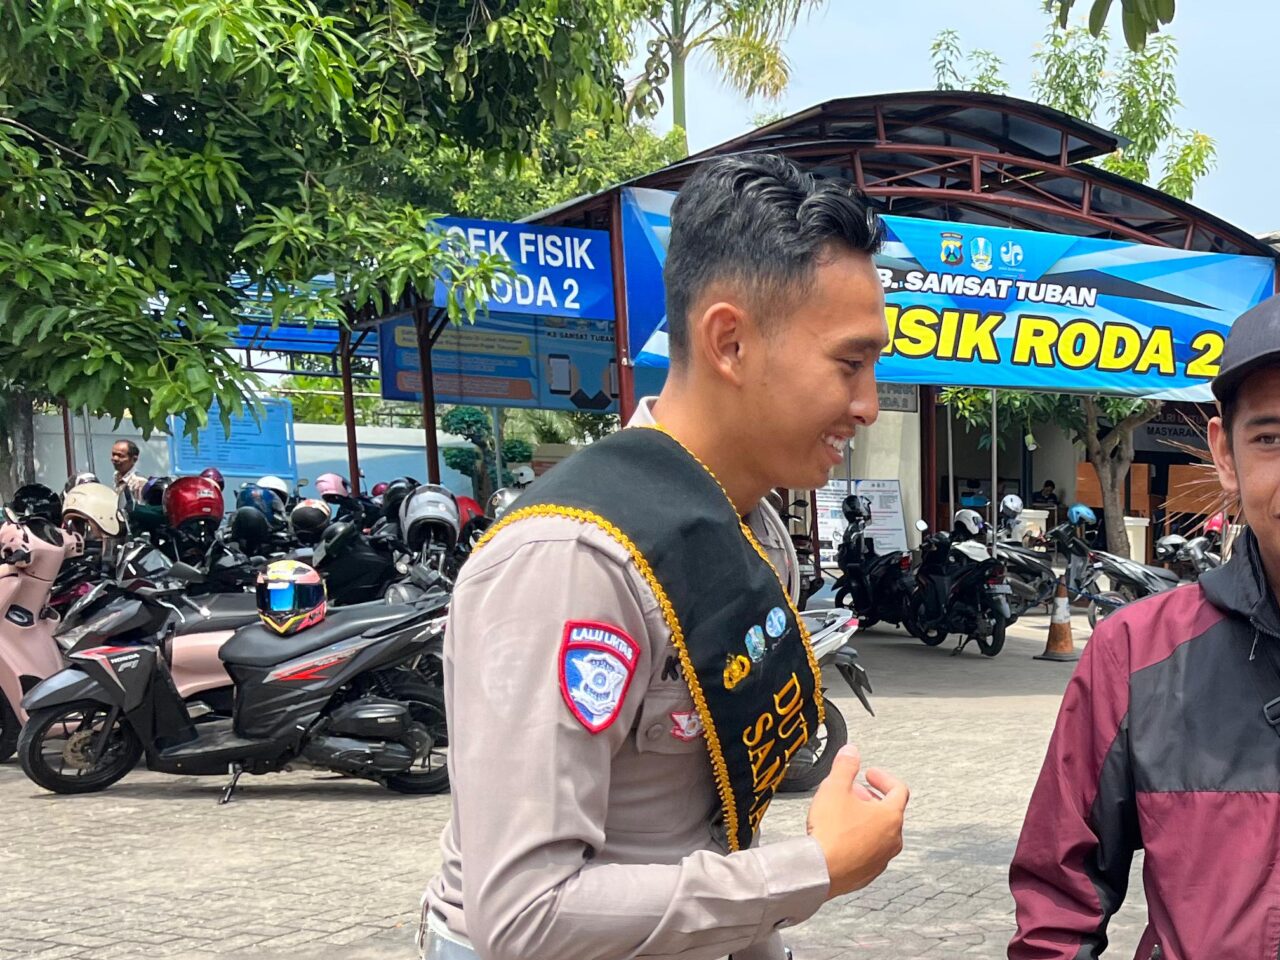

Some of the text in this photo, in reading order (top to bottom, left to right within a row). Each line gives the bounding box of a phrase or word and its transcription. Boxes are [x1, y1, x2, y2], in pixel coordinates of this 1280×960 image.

[519, 232, 595, 270] FISIK
[470, 271, 580, 310] ODA 2
[904, 271, 1014, 300] SAMSAT
[1016, 279, 1097, 307] TUBAN
[880, 306, 1225, 377] ISIK RODA 2
